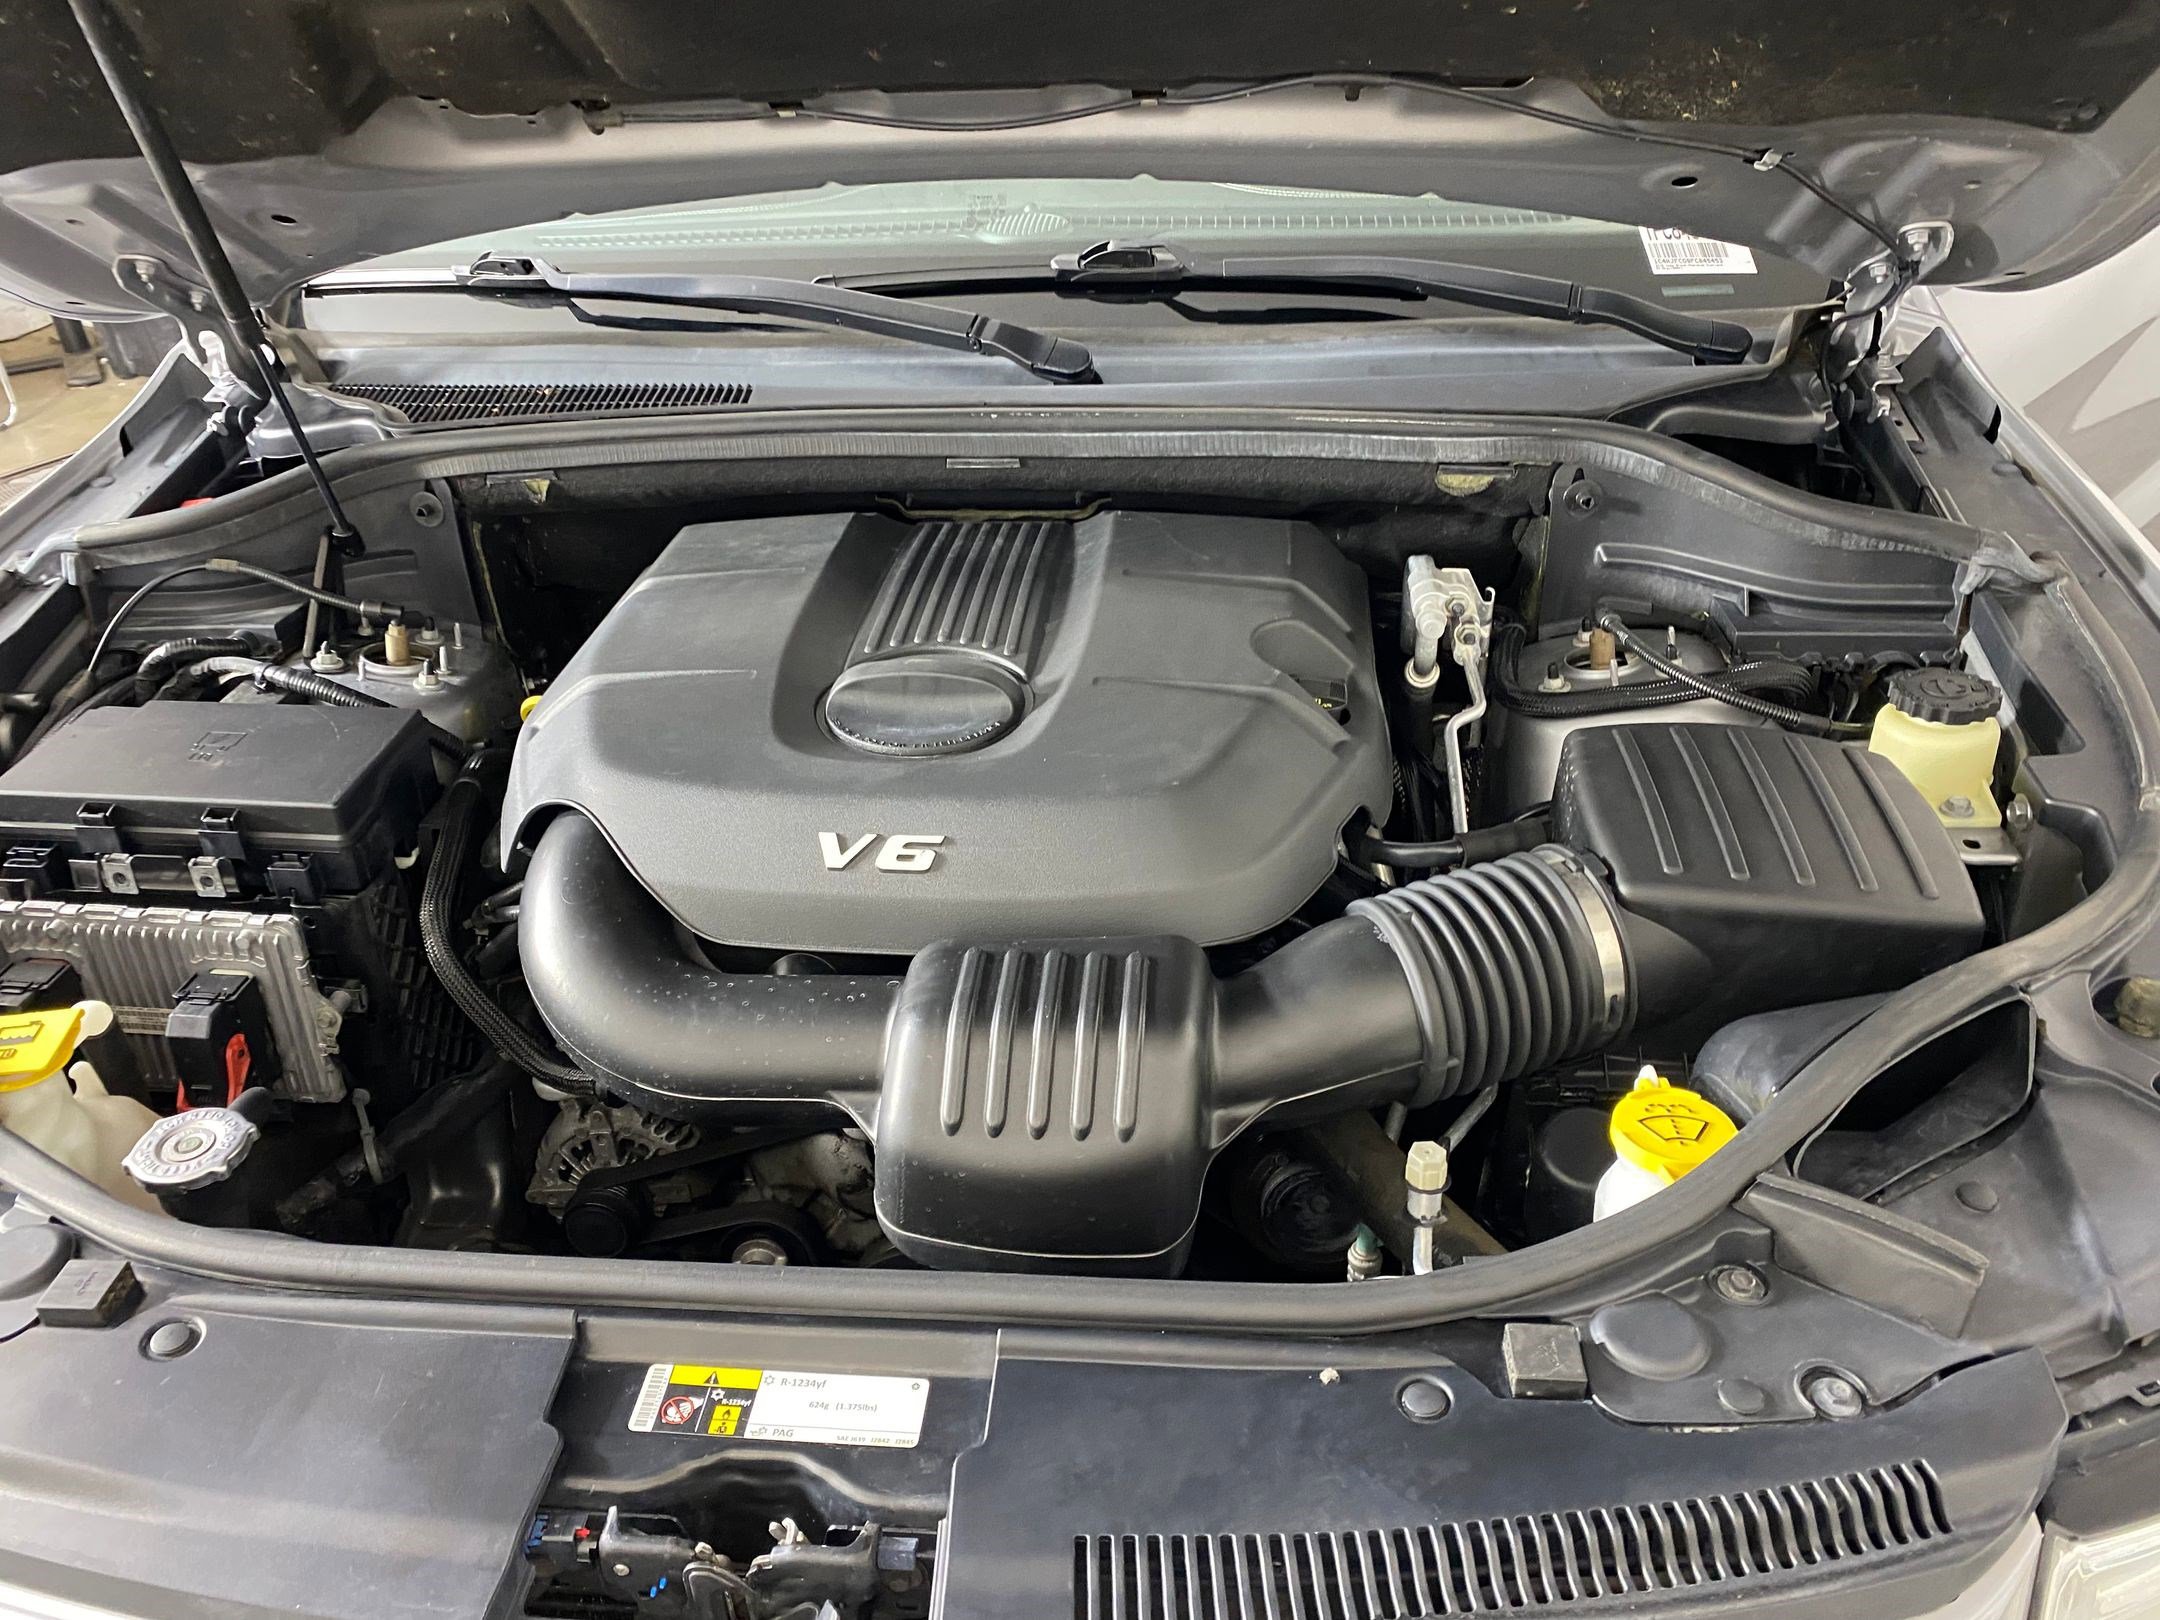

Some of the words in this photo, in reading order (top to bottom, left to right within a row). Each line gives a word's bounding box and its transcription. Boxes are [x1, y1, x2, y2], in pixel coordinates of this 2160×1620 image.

[818, 832, 946, 874] V6
[780, 1378, 828, 1390] R-1234yf
[808, 1401, 830, 1411] 624g
[835, 1402, 878, 1413] (1.375lbs)
[772, 1428, 794, 1438] PAG
